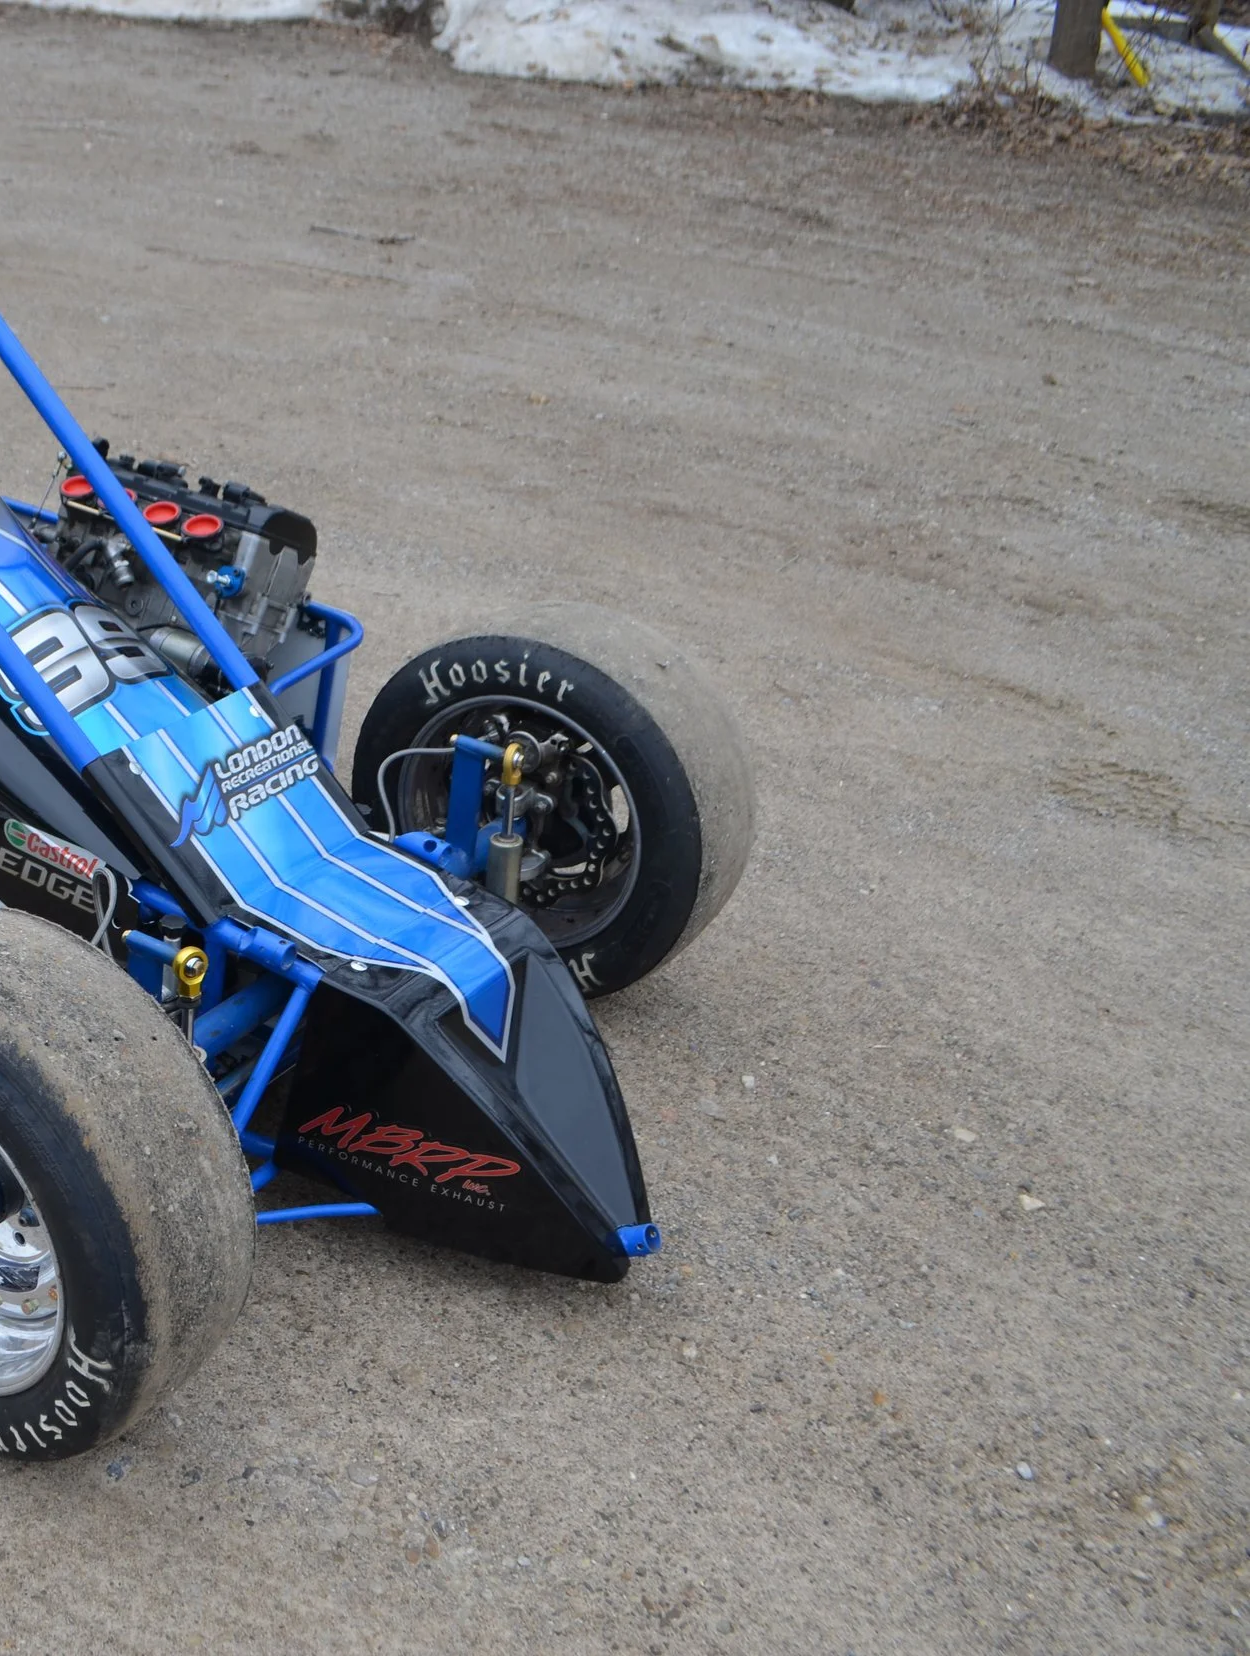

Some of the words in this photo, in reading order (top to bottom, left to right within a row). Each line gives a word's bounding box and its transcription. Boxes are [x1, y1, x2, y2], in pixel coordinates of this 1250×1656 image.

[418, 651, 575, 704] Hoosier
[26, 832, 100, 880] Castrol
[298, 1136, 419, 1187] PERFORMANCE
[430, 1183, 506, 1212] EXHAUST
[299, 1106, 521, 1183] MBRP
